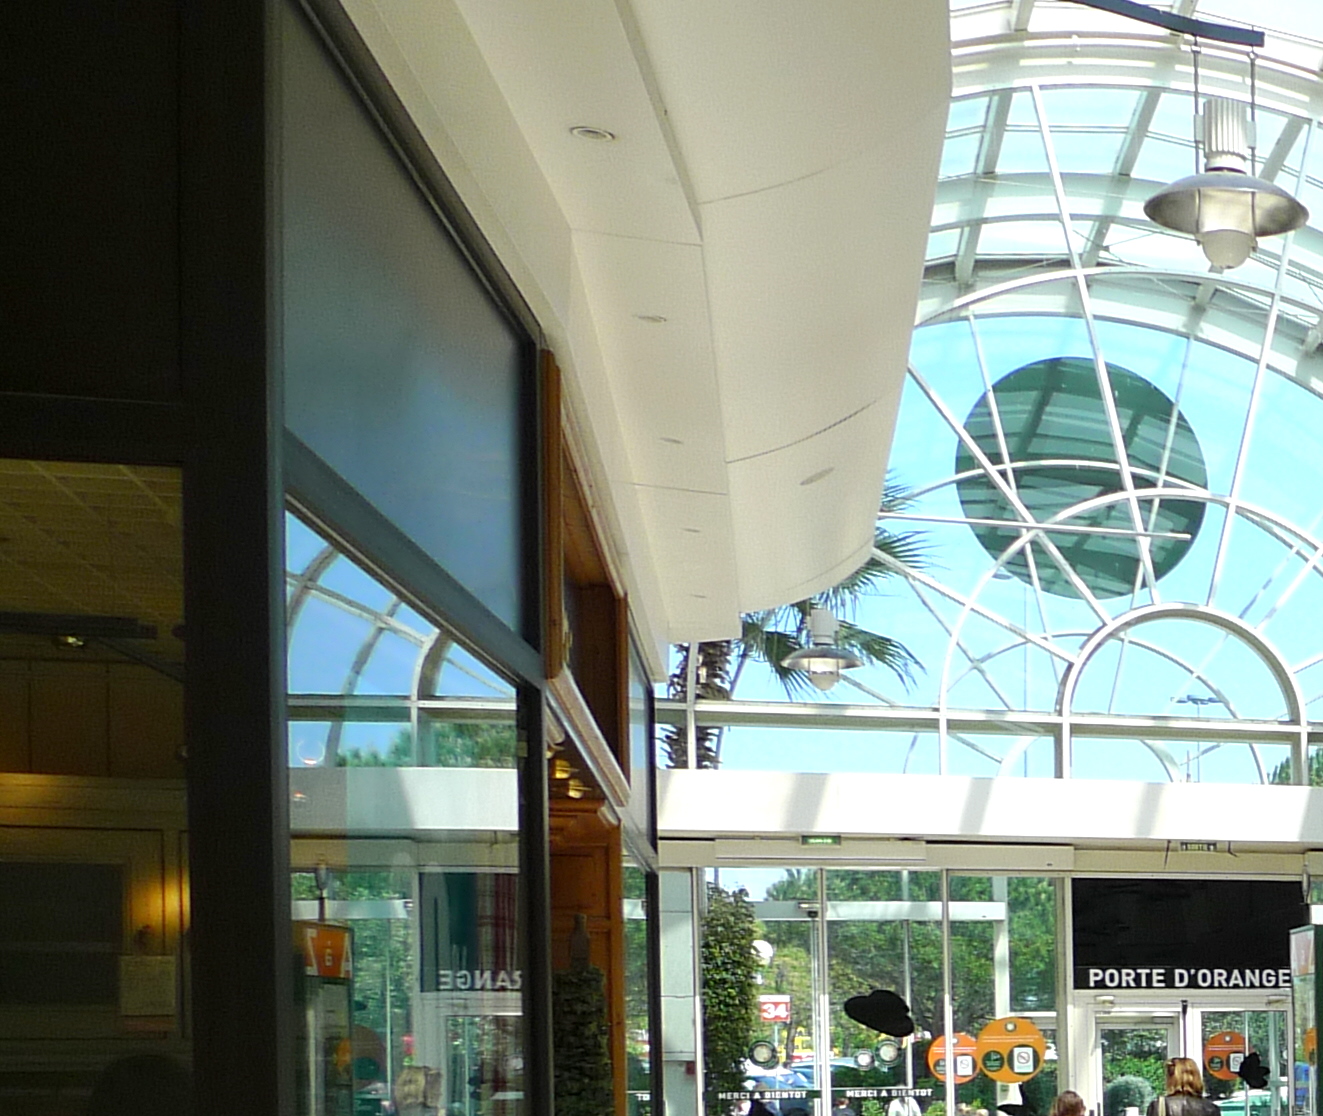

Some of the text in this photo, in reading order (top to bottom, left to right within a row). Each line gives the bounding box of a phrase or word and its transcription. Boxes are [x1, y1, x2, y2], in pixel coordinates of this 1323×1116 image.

[1088, 968, 1291, 988] PORTE D'ORANGE
[762, 1003, 789, 1019] 34
[718, 1091, 750, 1100] MERCI
[764, 1090, 807, 1099] BIENTOT
[846, 1089, 877, 1098] MERCI
[891, 1088, 933, 1097] BIENTOT
